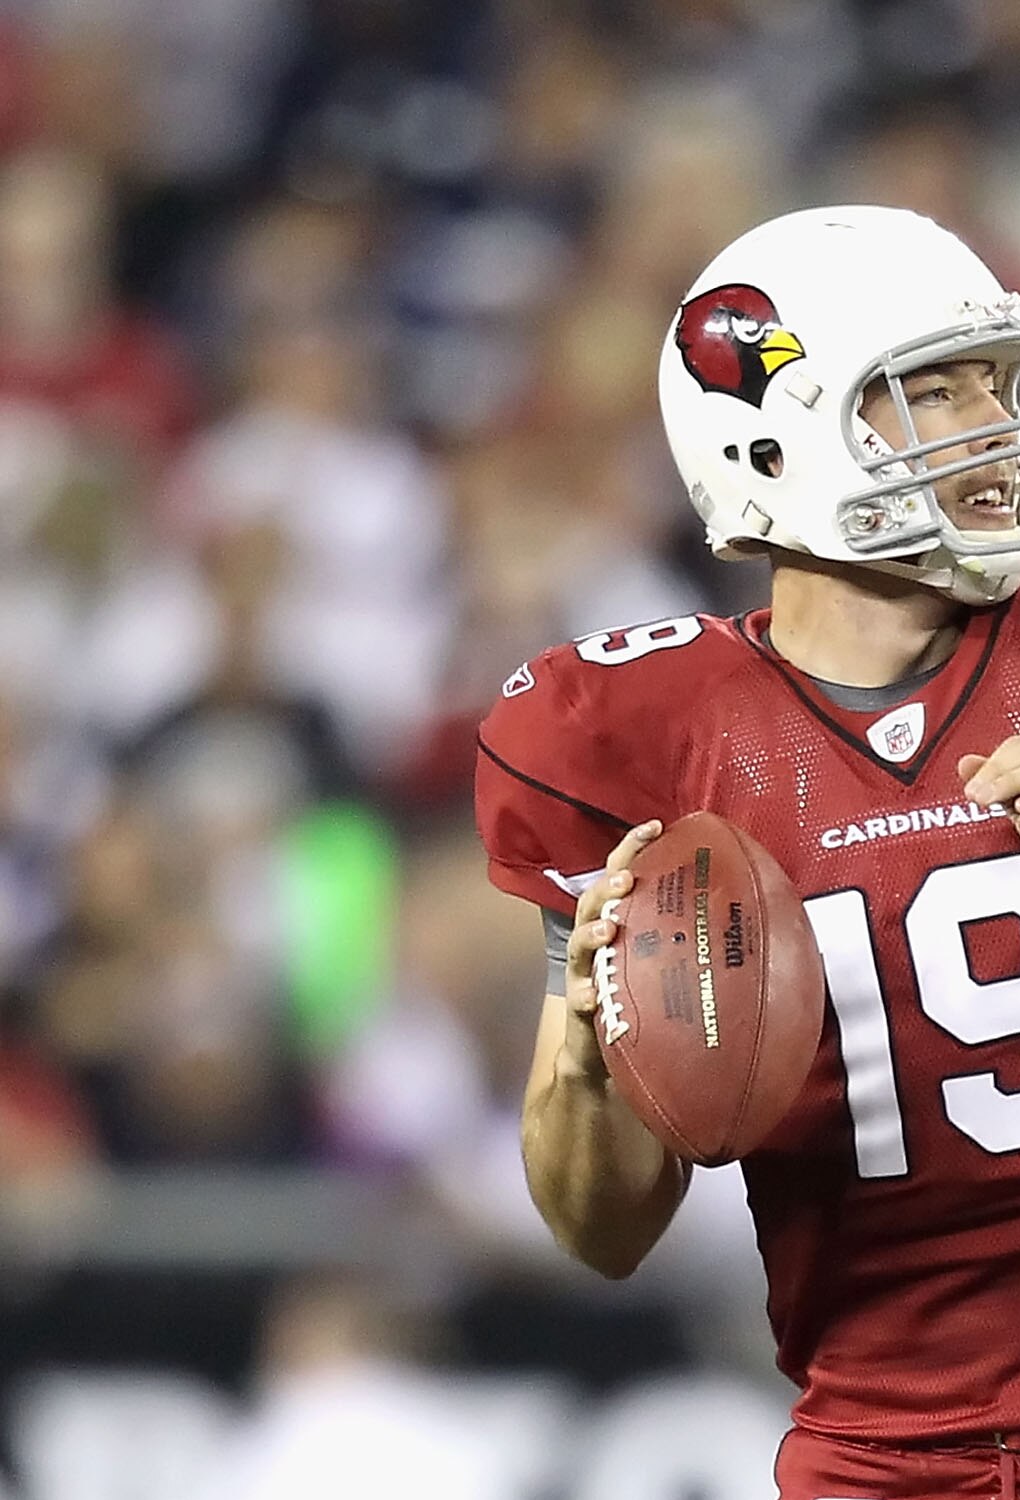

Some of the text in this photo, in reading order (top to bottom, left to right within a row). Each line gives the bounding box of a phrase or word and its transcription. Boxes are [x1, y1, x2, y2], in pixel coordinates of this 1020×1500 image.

[695, 892, 712, 966] FOOTBALL
[723, 902, 744, 969] Wilson
[699, 968, 720, 1049] NATIONAL
